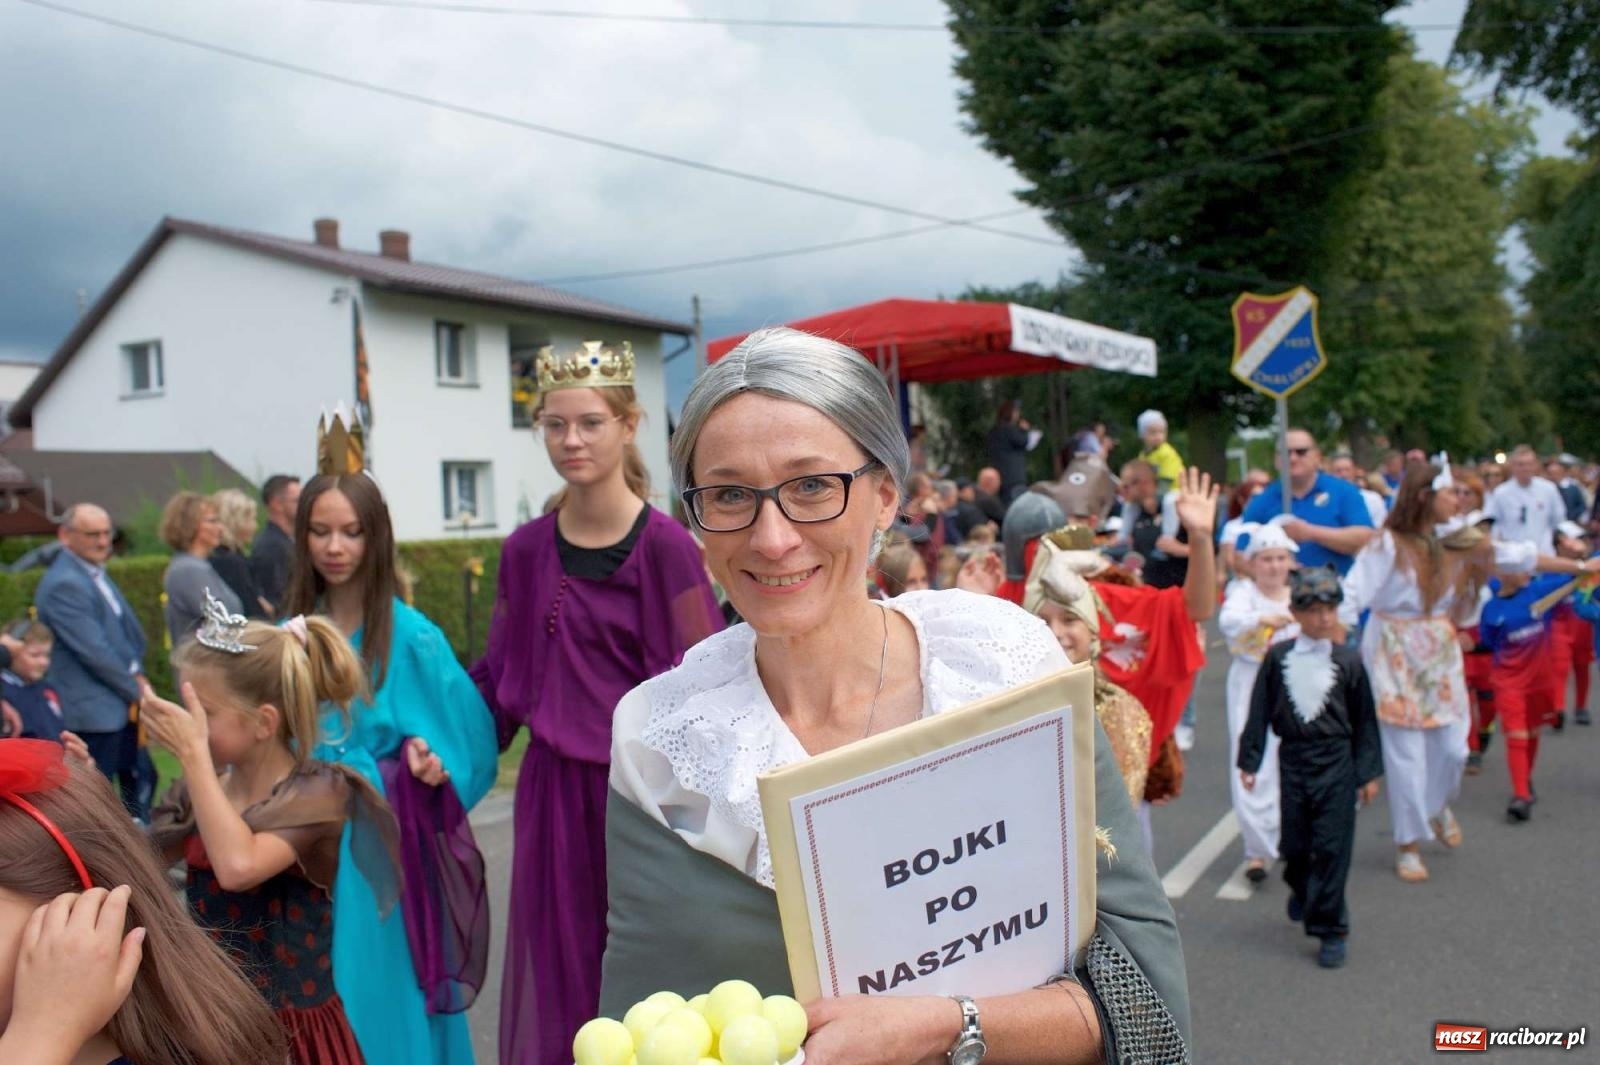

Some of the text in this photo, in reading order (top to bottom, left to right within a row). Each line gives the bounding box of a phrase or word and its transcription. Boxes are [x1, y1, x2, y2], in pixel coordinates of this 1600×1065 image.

[883, 819, 1007, 889] BOJKI
[925, 885, 978, 925] PO
[857, 902, 1049, 994] NASZYMU
